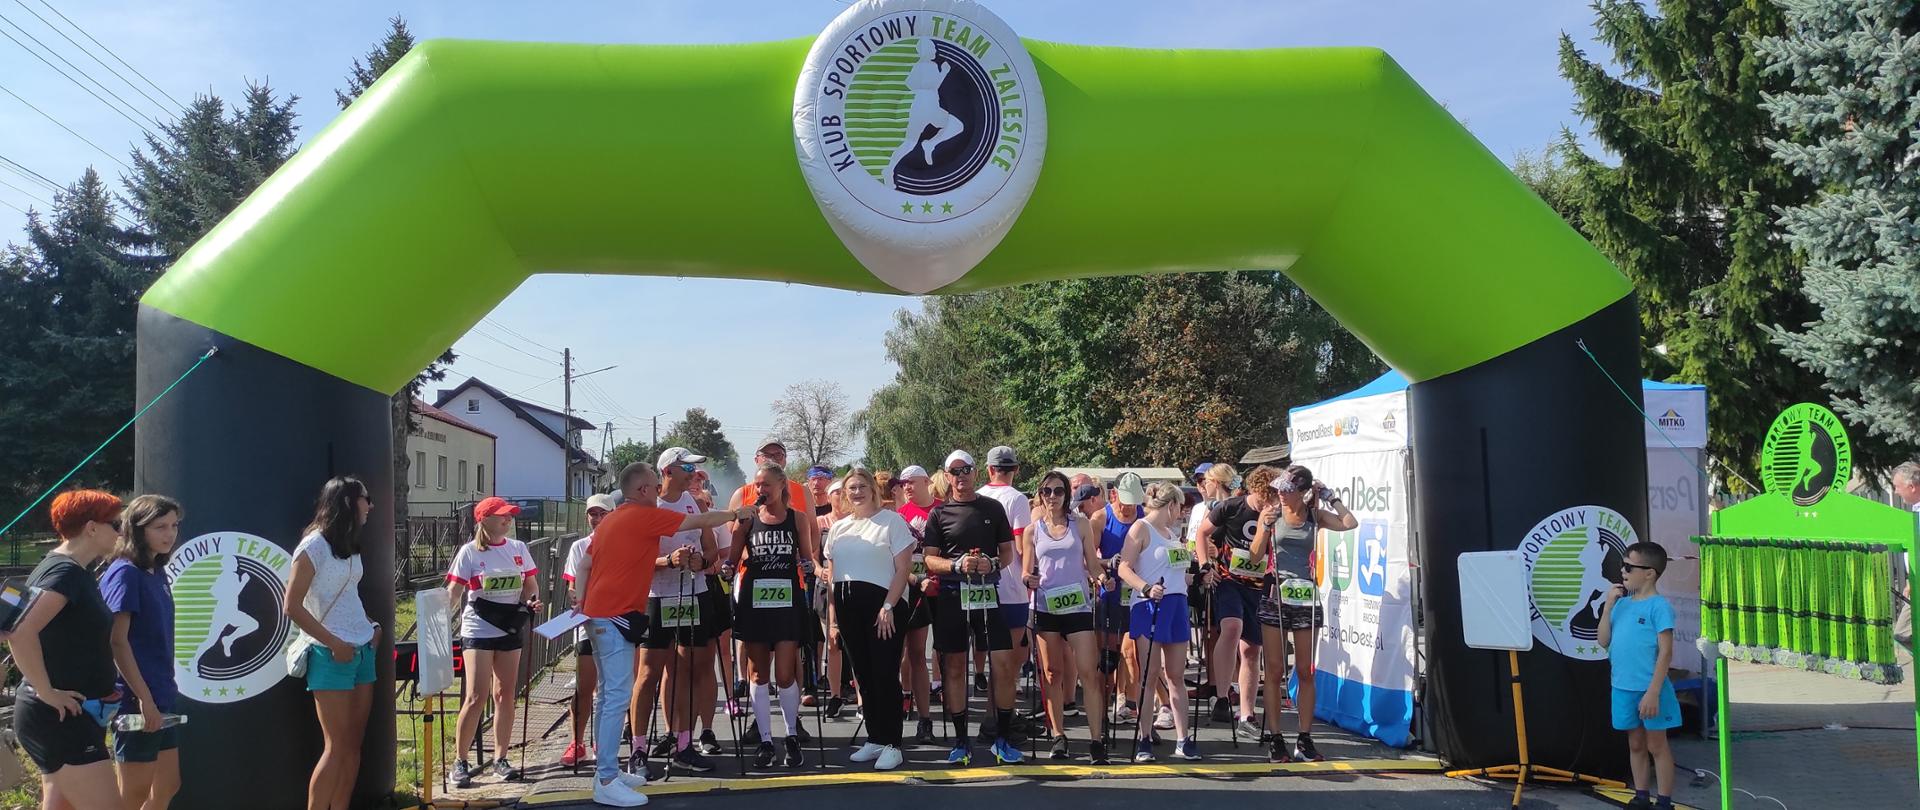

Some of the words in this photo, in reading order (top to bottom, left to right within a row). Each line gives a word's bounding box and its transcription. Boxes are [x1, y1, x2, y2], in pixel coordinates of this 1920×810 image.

[931, 16, 992, 59] TEAM
[824, 15, 917, 100] SPORTOWY
[988, 62, 1023, 173] ZALESICE
[821, 114, 855, 172] KLUB
[1658, 418, 1685, 427] MITKO
[1766, 407, 1802, 457] SPORTOWY
[1809, 407, 1835, 431] TEAM
[1832, 431, 1848, 495] ZALESICE
[1598, 510, 1631, 542] TEAM
[750, 530, 794, 546] ANGELS
[237, 537, 288, 572] TEAM
[751, 544, 792, 556] NEVER
[761, 556, 790, 571] alone
[913, 562, 925, 573] 27
[490, 576, 516, 590] 277
[760, 587, 786, 600] 276
[969, 589, 991, 602] 273
[1286, 587, 1312, 599] 284
[1053, 593, 1079, 609] 302
[669, 606, 695, 619] 294
